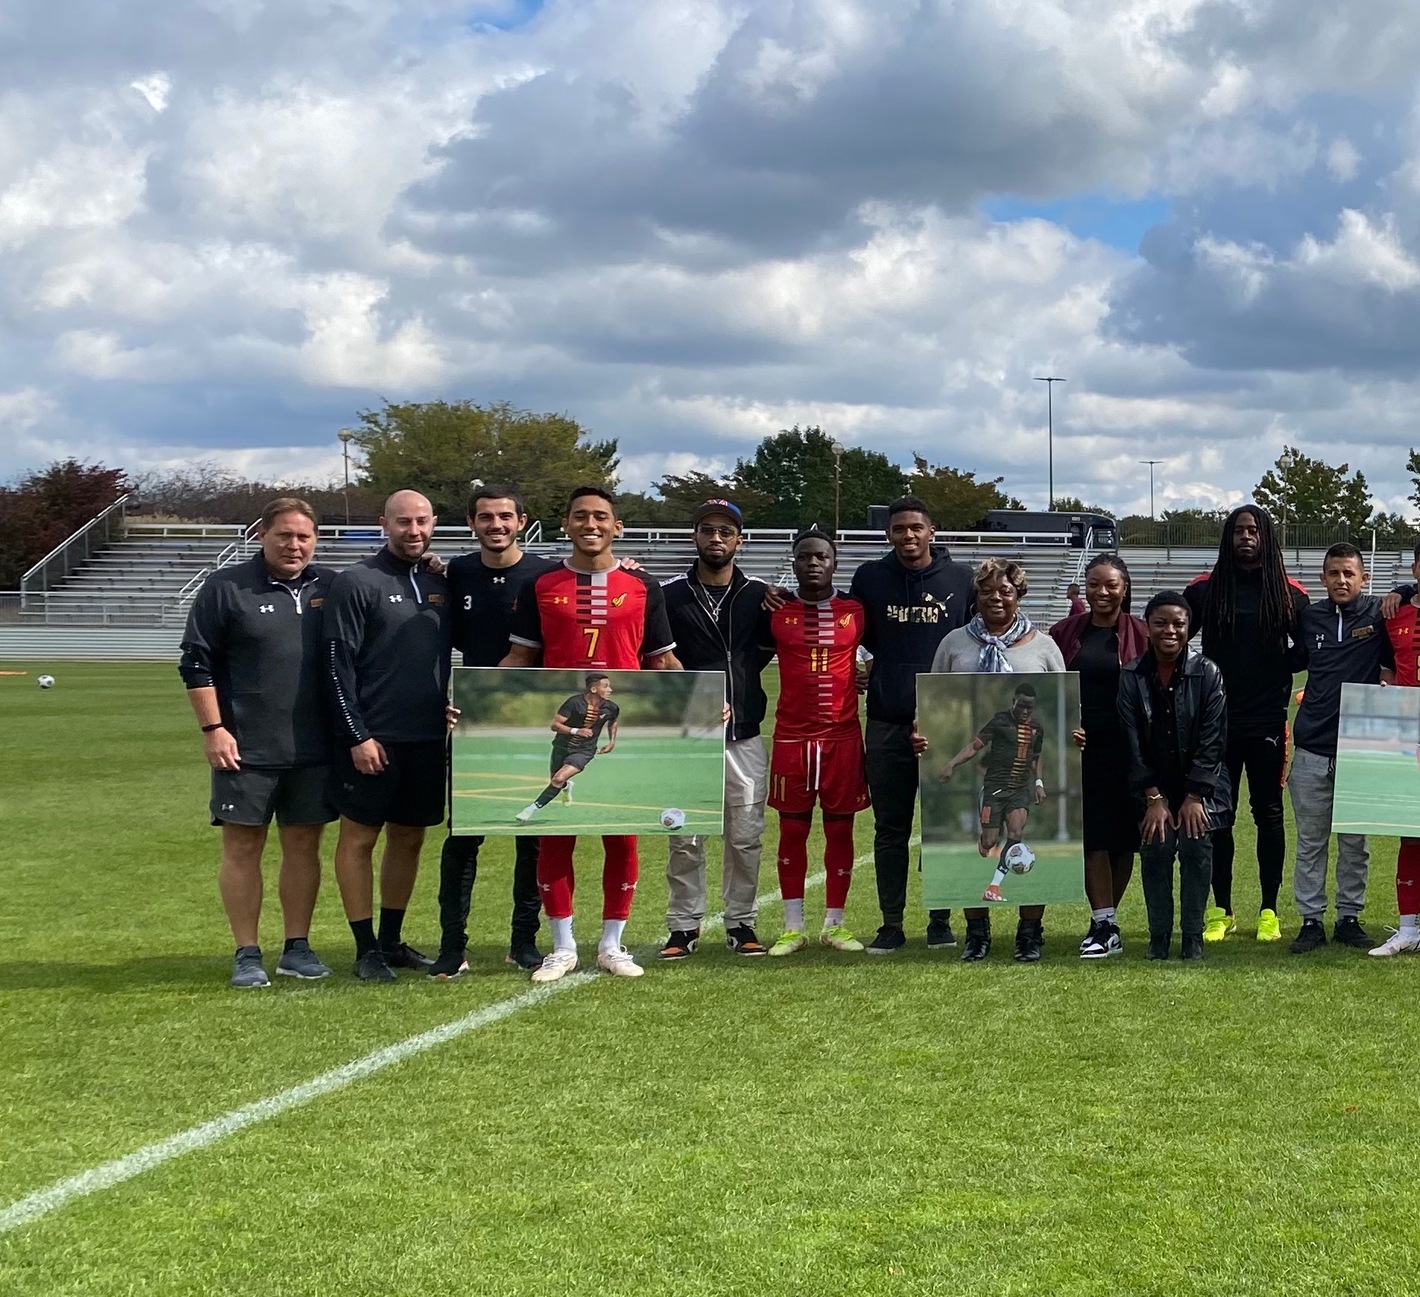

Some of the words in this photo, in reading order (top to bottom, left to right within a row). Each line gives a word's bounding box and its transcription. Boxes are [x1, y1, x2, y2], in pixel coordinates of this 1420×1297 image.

[463, 595, 472, 610] 3
[583, 627, 600, 659] 7
[810, 647, 829, 672] 11
[773, 773, 786, 802] 11
